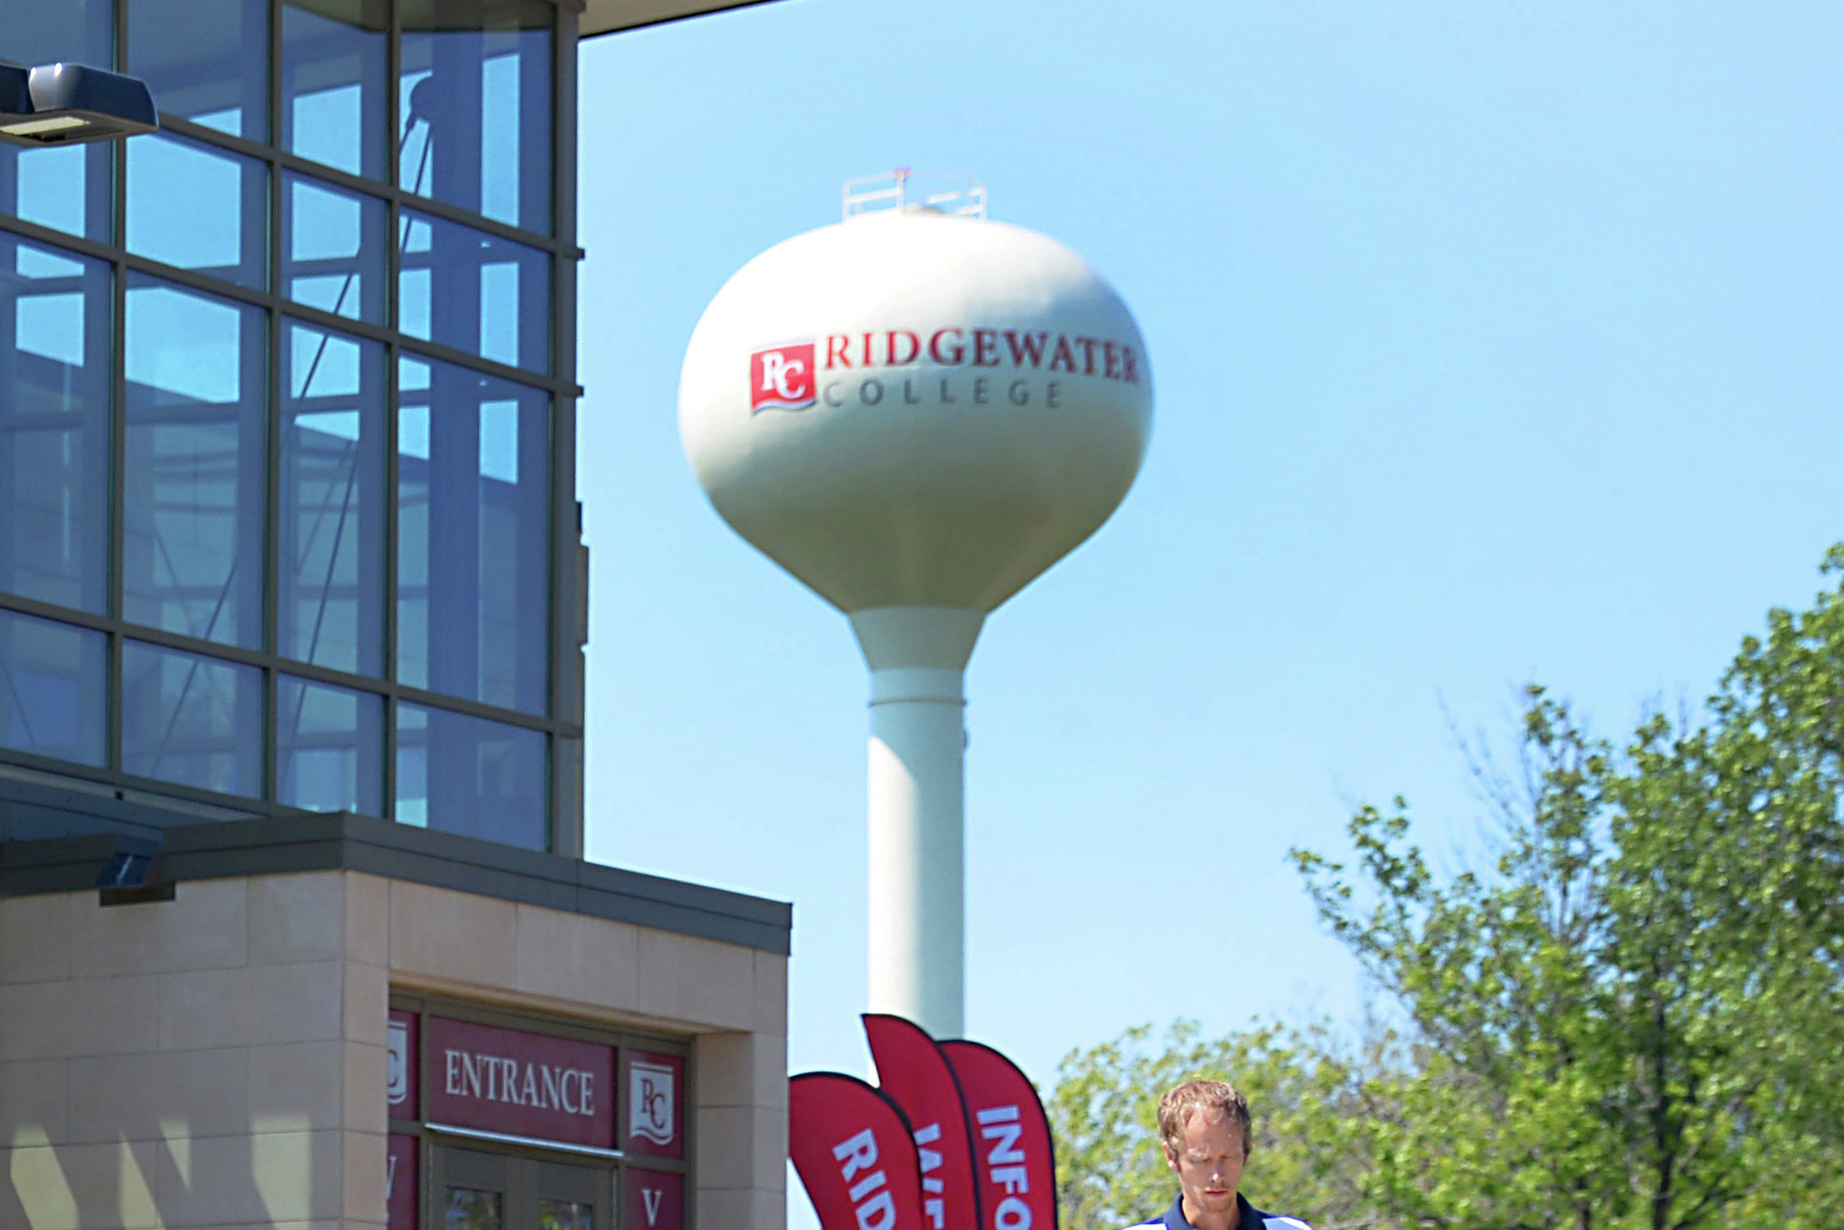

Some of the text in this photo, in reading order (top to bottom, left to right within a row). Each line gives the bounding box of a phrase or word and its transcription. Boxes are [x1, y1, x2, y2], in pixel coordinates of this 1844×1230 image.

[825, 328, 1140, 384] RIDGEWATER
[823, 378, 1062, 408] COLLEGE
[445, 1049, 595, 1116] ENTRANCE
